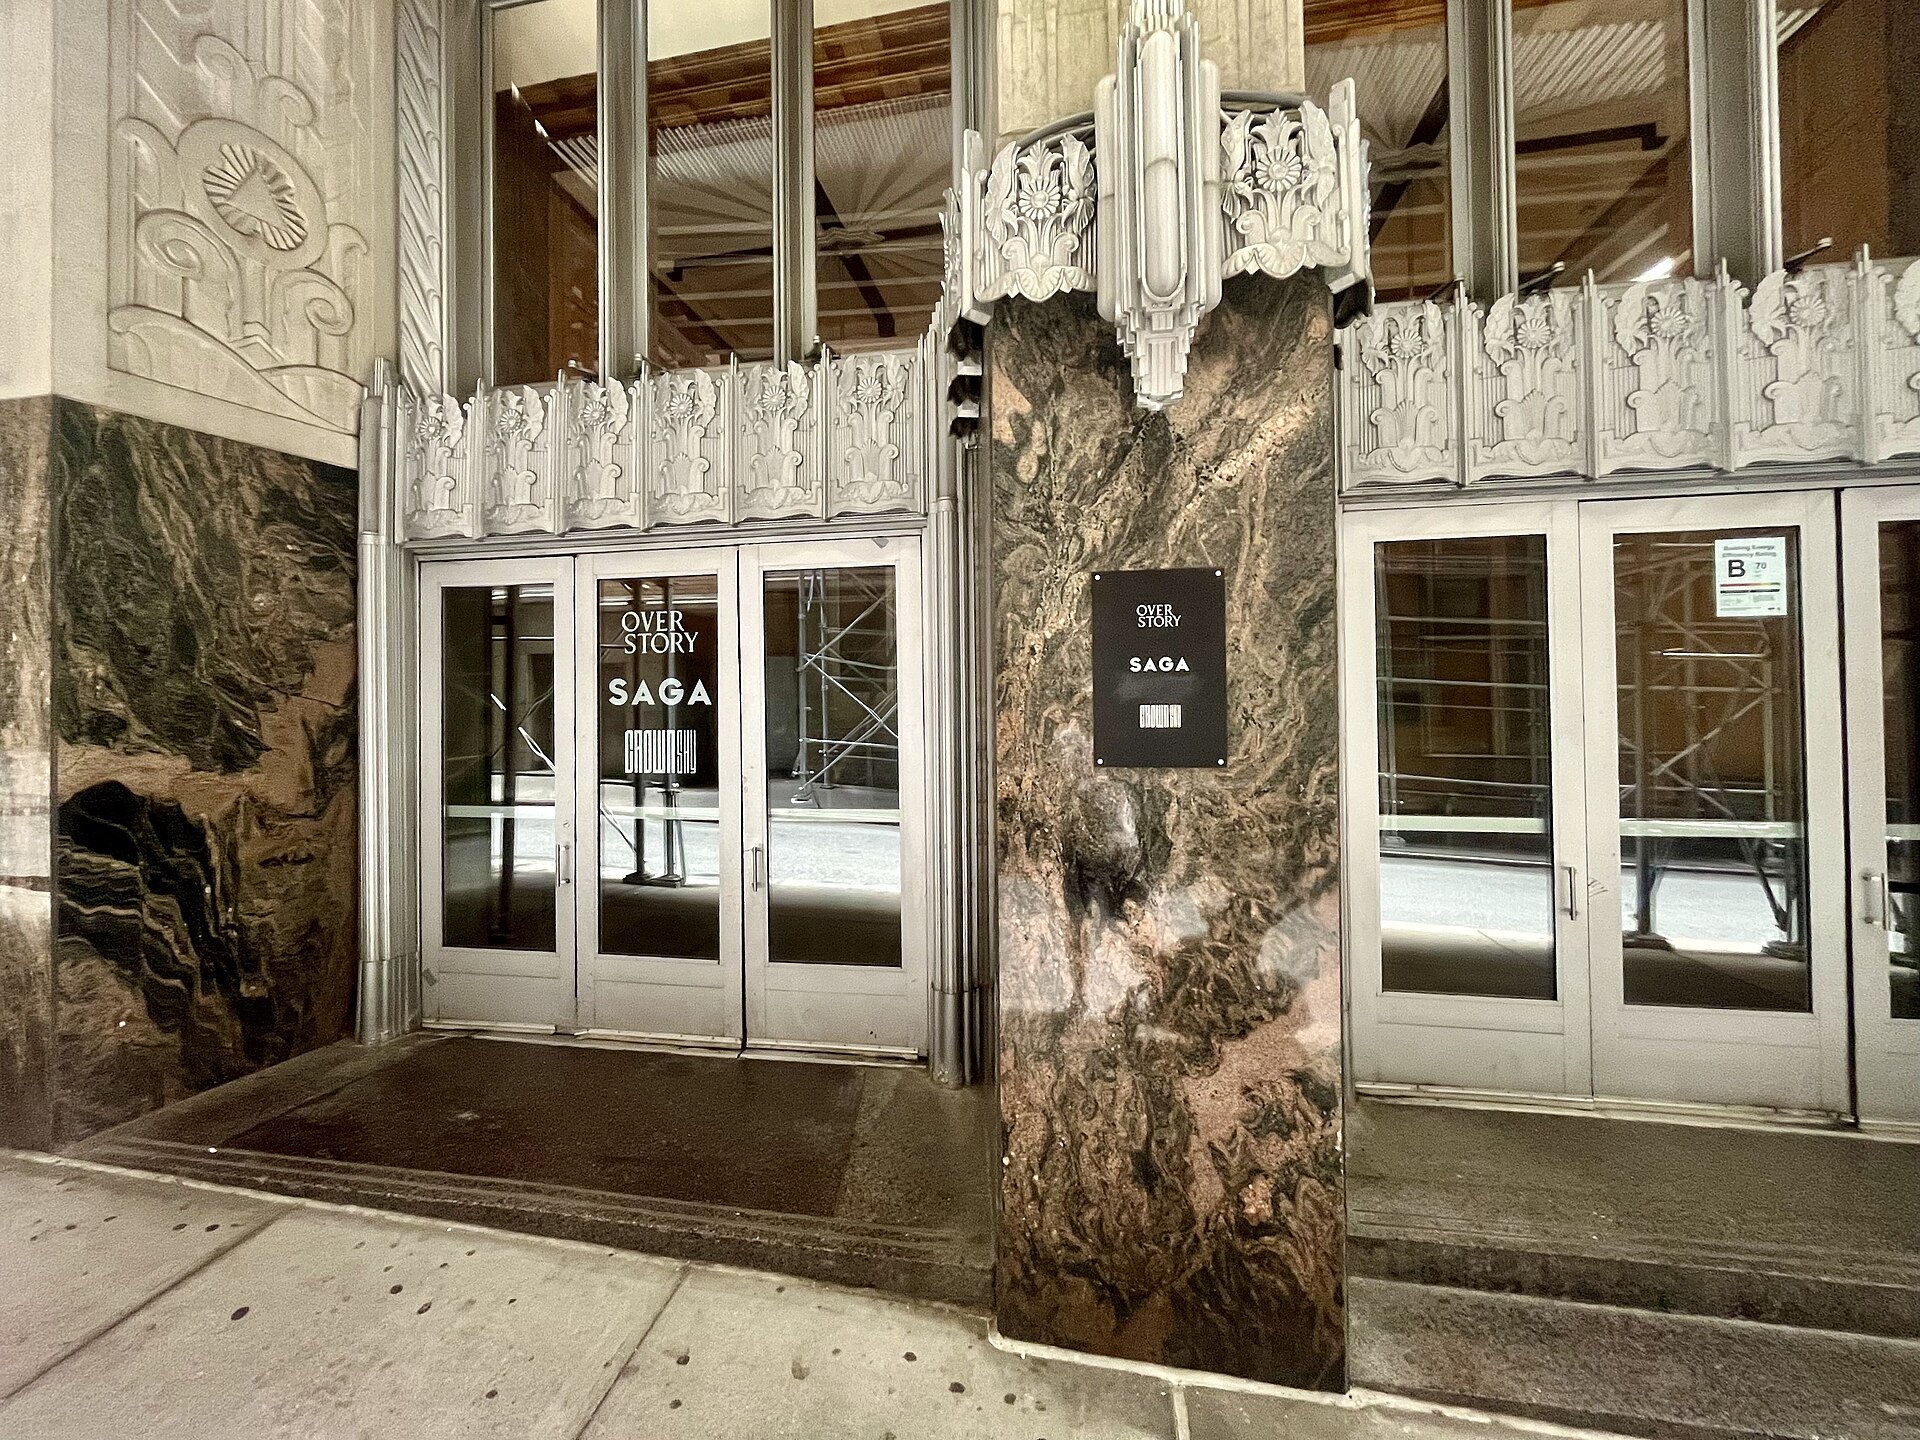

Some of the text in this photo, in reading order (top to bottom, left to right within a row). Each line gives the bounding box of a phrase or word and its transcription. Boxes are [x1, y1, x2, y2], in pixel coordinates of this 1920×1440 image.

[1728, 559, 1746, 577] B
[1136, 604, 1173, 615] OVER
[621, 610, 684, 632] OVER
[1137, 615, 1181, 627] STORY
[624, 631, 699, 654] STORY
[1129, 656, 1190, 673] SAGA
[608, 677, 712, 706] SAGA
